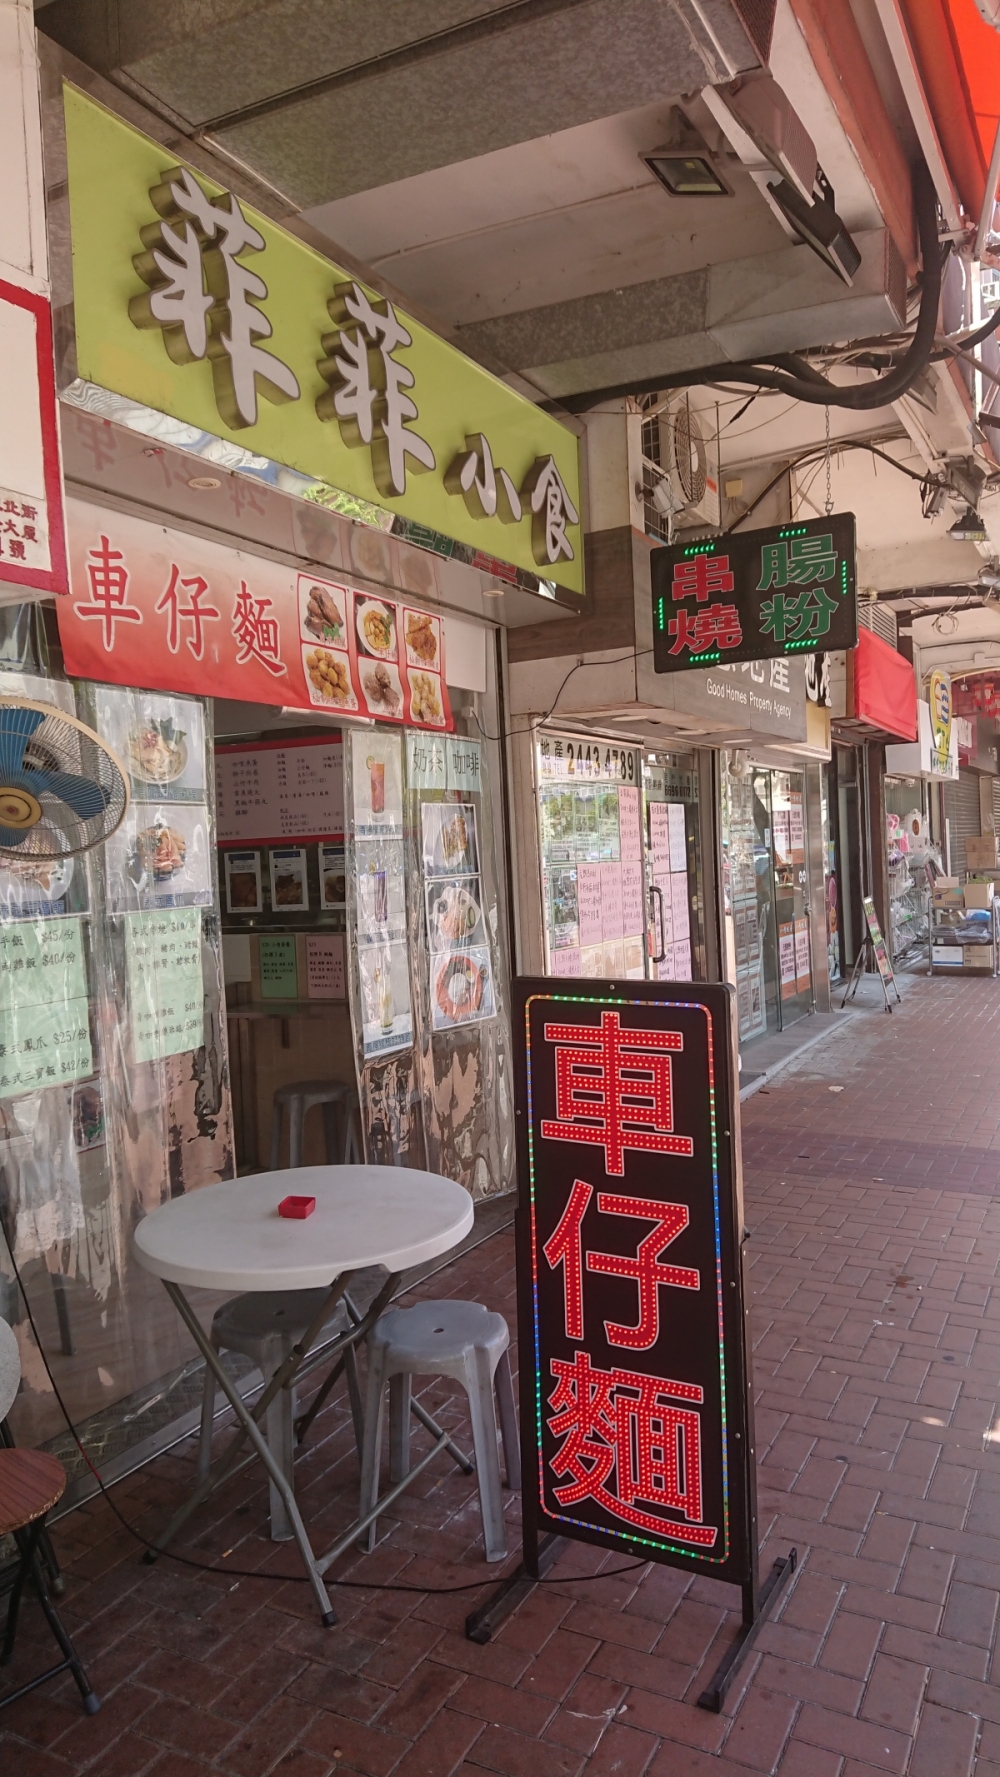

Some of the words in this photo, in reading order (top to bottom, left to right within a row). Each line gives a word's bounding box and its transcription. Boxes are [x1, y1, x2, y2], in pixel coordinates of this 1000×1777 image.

[129, 165, 580, 565] 菲菲小食
[0, 500, 38, 521] 北街
[76, 534, 286, 676] 車仔麵
[668, 553, 743, 655] 串燒
[756, 534, 839, 642] 腸粉
[706, 677, 725, 698] Good
[726, 683, 747, 705] Homes
[749, 691, 772, 715] Property
[774, 700, 791, 720] Agency
[413, 747, 443, 773] 奶茶
[452, 750, 479, 777] 咖啡
[567, 742, 601, 777] 2443
[605, 748, 633, 780] 4789
[540, 1010, 717, 1548] 車仔麵
